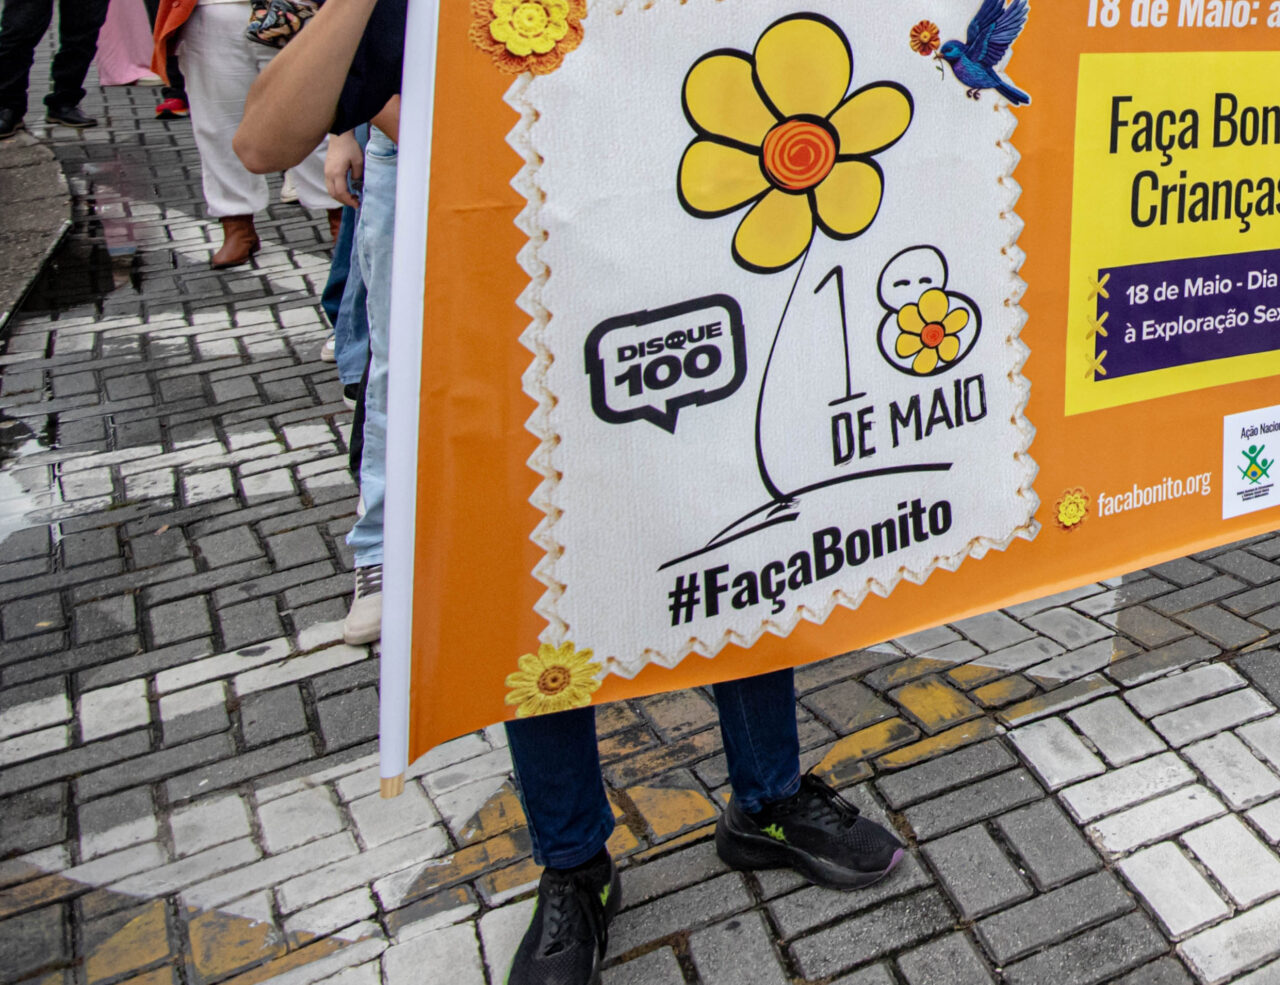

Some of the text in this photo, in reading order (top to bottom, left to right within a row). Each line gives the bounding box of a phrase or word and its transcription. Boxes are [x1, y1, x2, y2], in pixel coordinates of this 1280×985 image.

[1109, 96, 1199, 167] Faça
[1126, 284, 1149, 305] 18
[1153, 281, 1179, 302] de
[1184, 274, 1232, 298] Maio
[1247, 269, 1278, 290] Dia
[616, 321, 722, 363] DISQUE
[1124, 323, 1136, 343] à
[1142, 308, 1249, 341] Exploração
[614, 344, 721, 397] 100
[830, 374, 987, 466] DE MAIO
[1241, 425, 1258, 440] Ação
[1097, 472, 1212, 517] facabonito.org
[667, 498, 952, 627] #FaçaBonito
